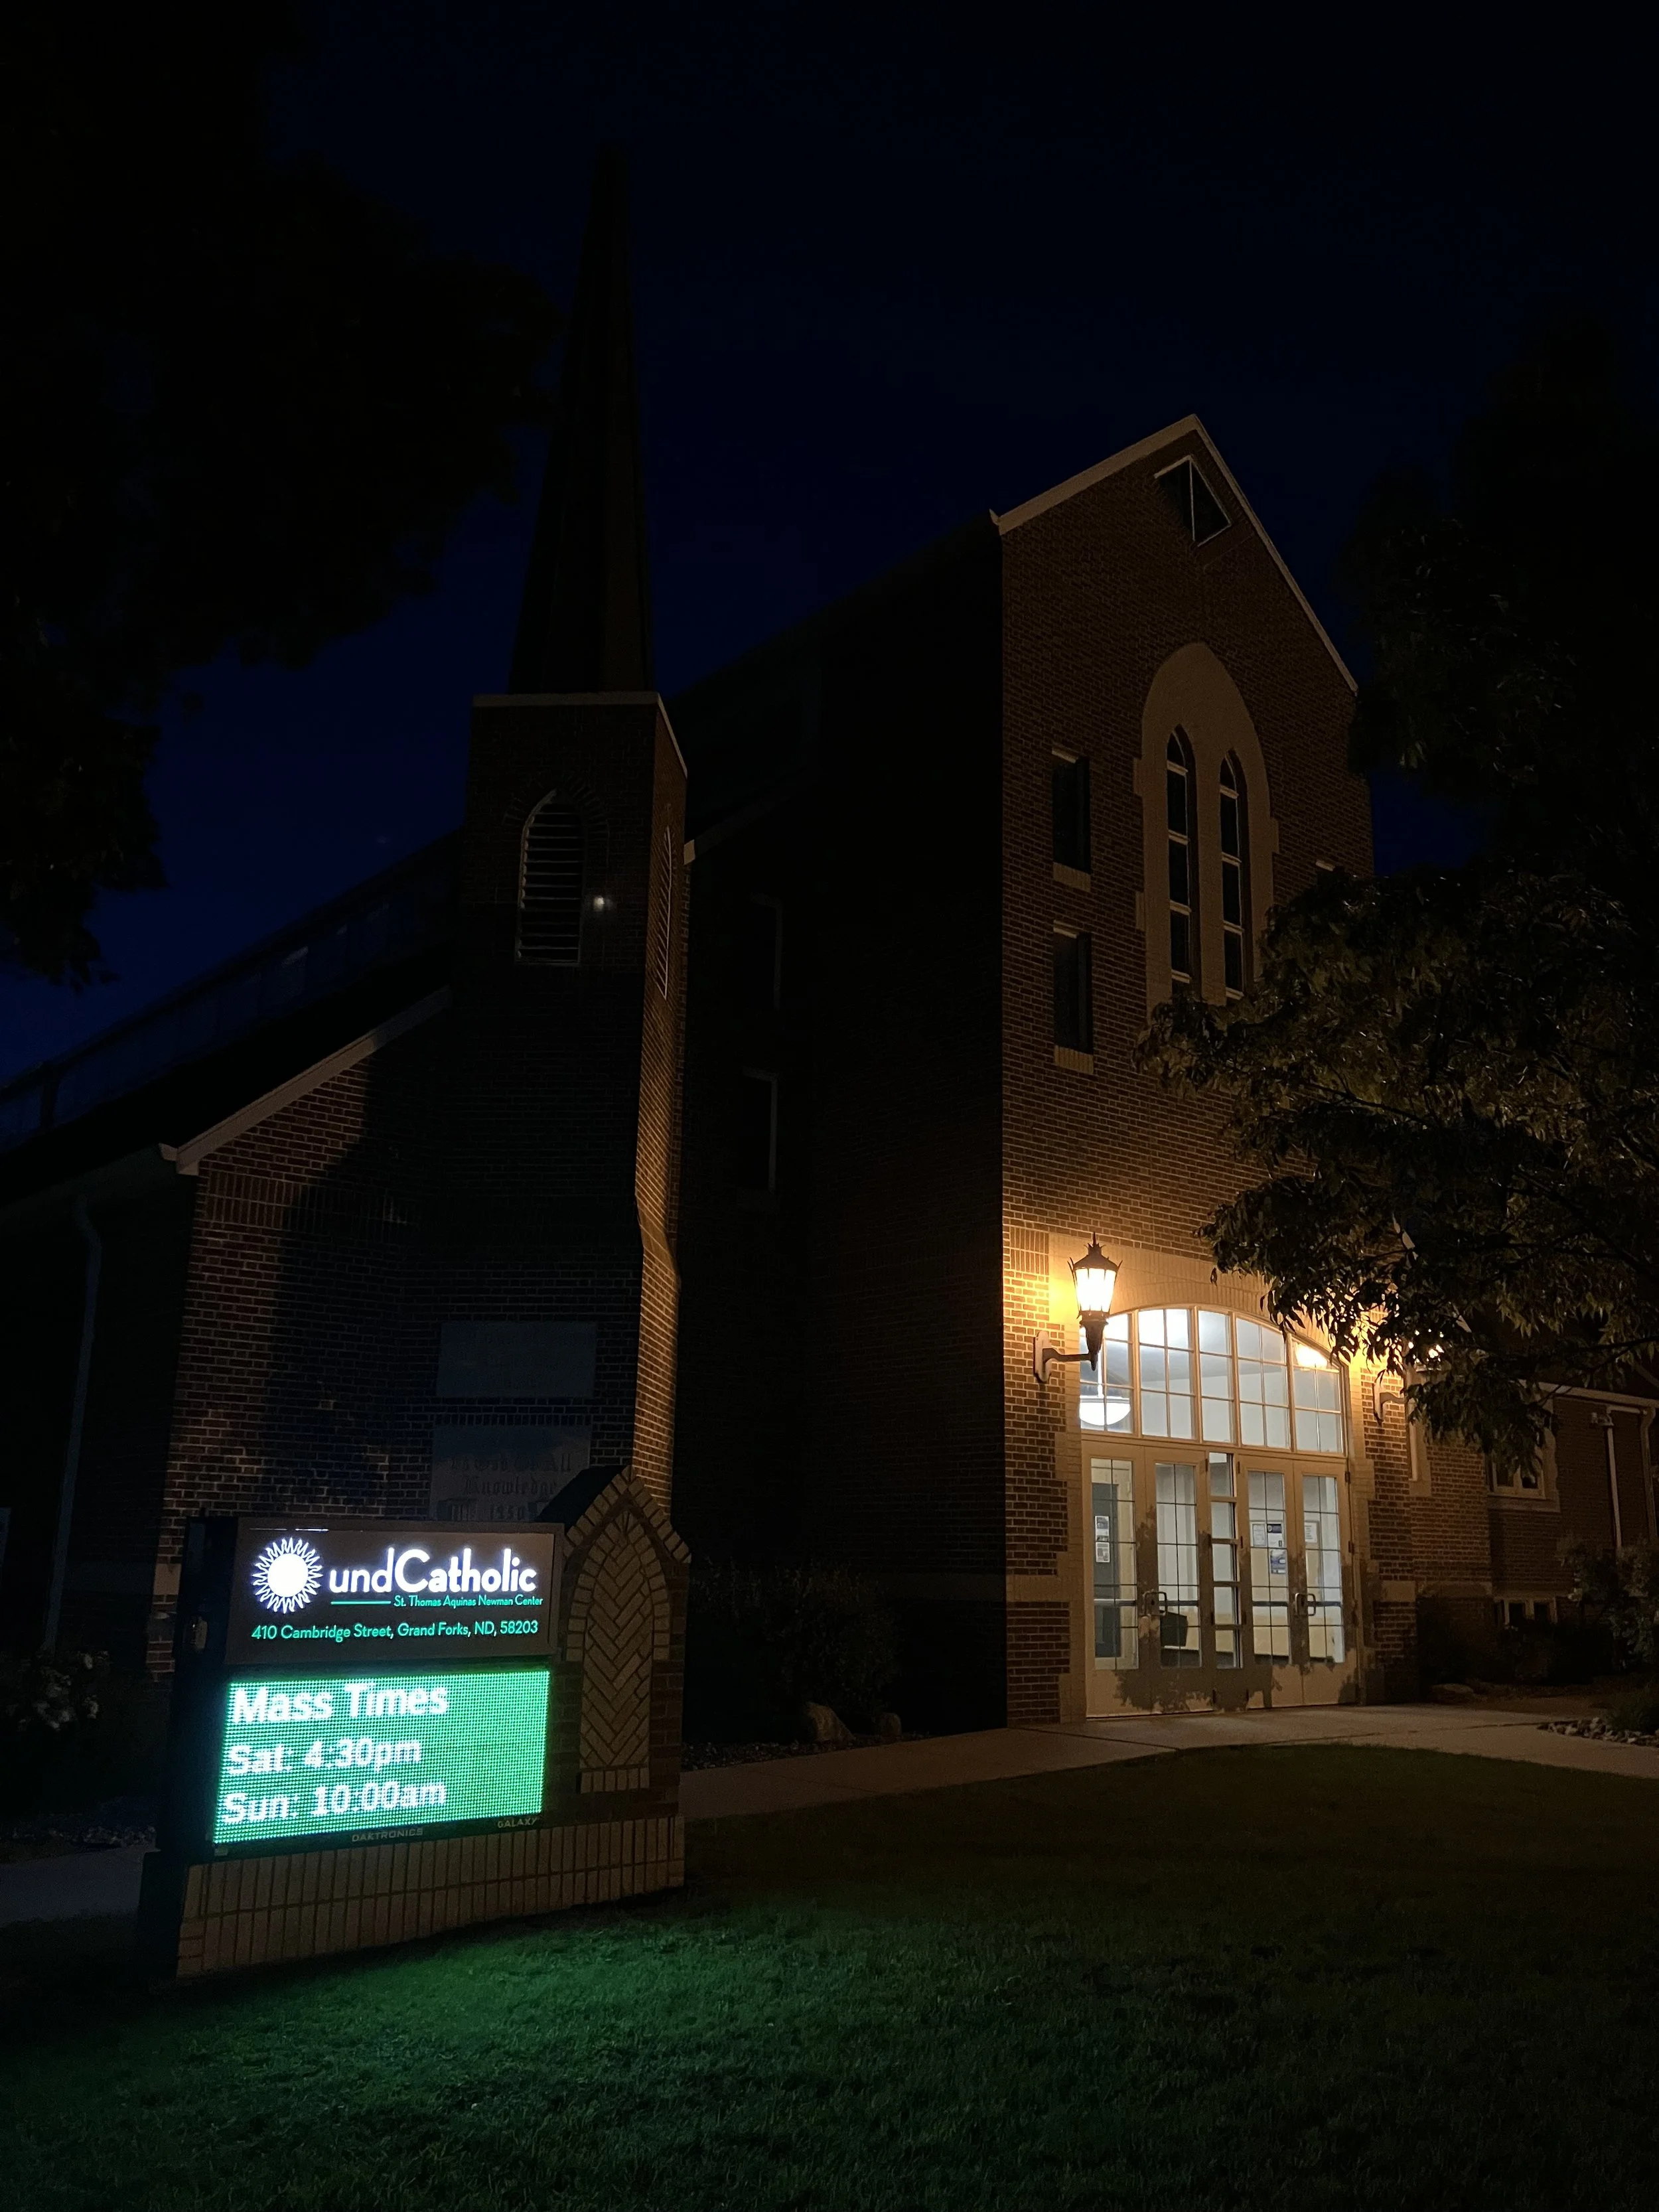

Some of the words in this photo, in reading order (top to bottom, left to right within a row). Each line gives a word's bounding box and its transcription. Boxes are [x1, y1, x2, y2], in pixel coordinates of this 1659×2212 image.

[328, 1546, 537, 1593] undCatholic
[393, 1595, 406, 1607] St.
[409, 1595, 441, 1607] Thomas
[443, 1595, 476, 1609] Aquinas
[478, 1594, 514, 1606] Newman
[514, 1593, 543, 1605] Center
[252, 1625, 277, 1639] 410
[281, 1624, 351, 1643] Cambridge
[353, 1622, 394, 1639] Street,
[398, 1621, 435, 1637] Grand
[437, 1621, 471, 1637] Forks,
[474, 1621, 497, 1637] ND,
[500, 1619, 538, 1635] 58203
[232, 1688, 332, 1724] Mass
[345, 1682, 448, 1718] Times
[305, 1737, 422, 1773] 4:30pm
[224, 1791, 298, 1823] Sun:
[312, 1781, 446, 1816] 10:00am
[497, 1817, 538, 1829] GALAXY
